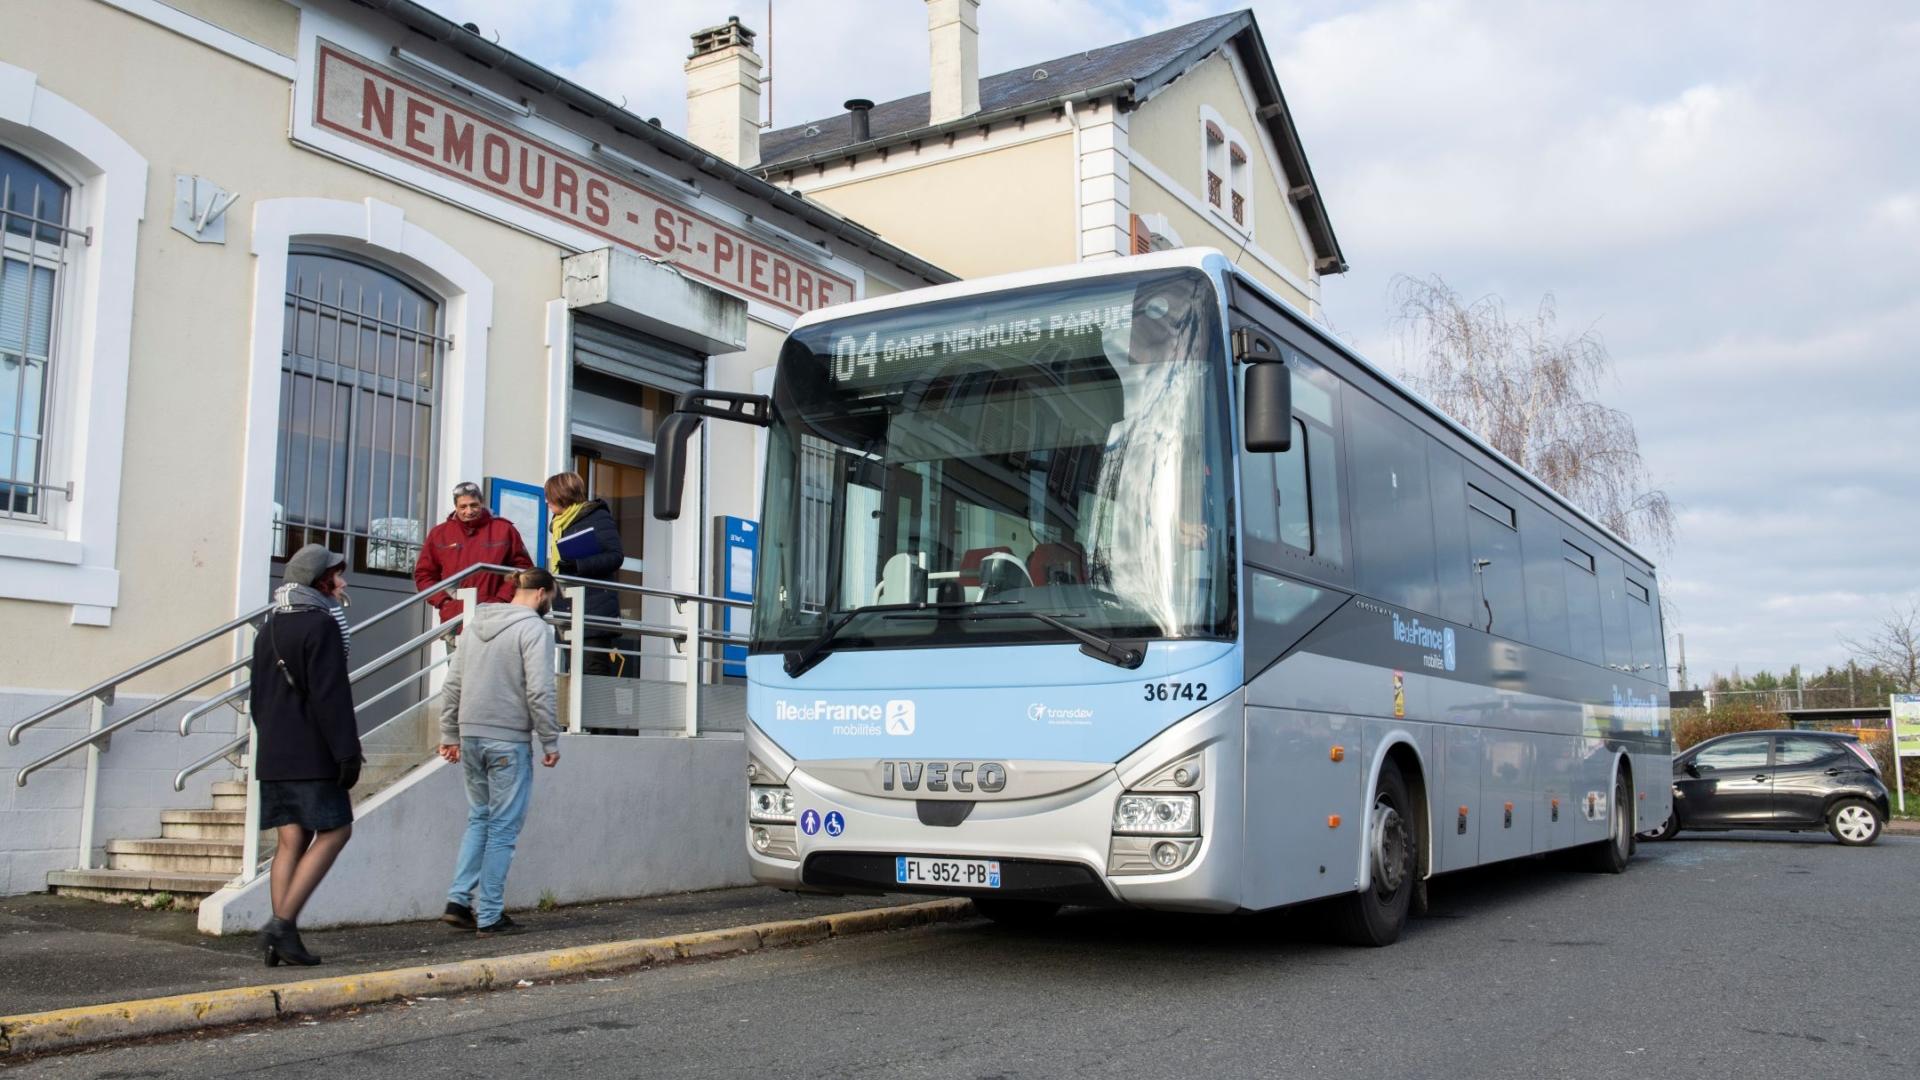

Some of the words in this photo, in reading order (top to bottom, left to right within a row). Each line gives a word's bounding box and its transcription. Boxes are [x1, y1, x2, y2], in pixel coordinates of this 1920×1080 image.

[362, 78, 610, 226] NEMOURS
[835, 332, 878, 382] 04
[883, 334, 935, 362] GARE
[942, 318, 1041, 353] NEMOURS
[1050, 304, 1133, 339] PARVIS
[1144, 683, 1208, 702] 36742
[1048, 708, 1094, 719] transdev
[832, 724, 882, 736] mobilités
[883, 761, 1007, 793] IVECO
